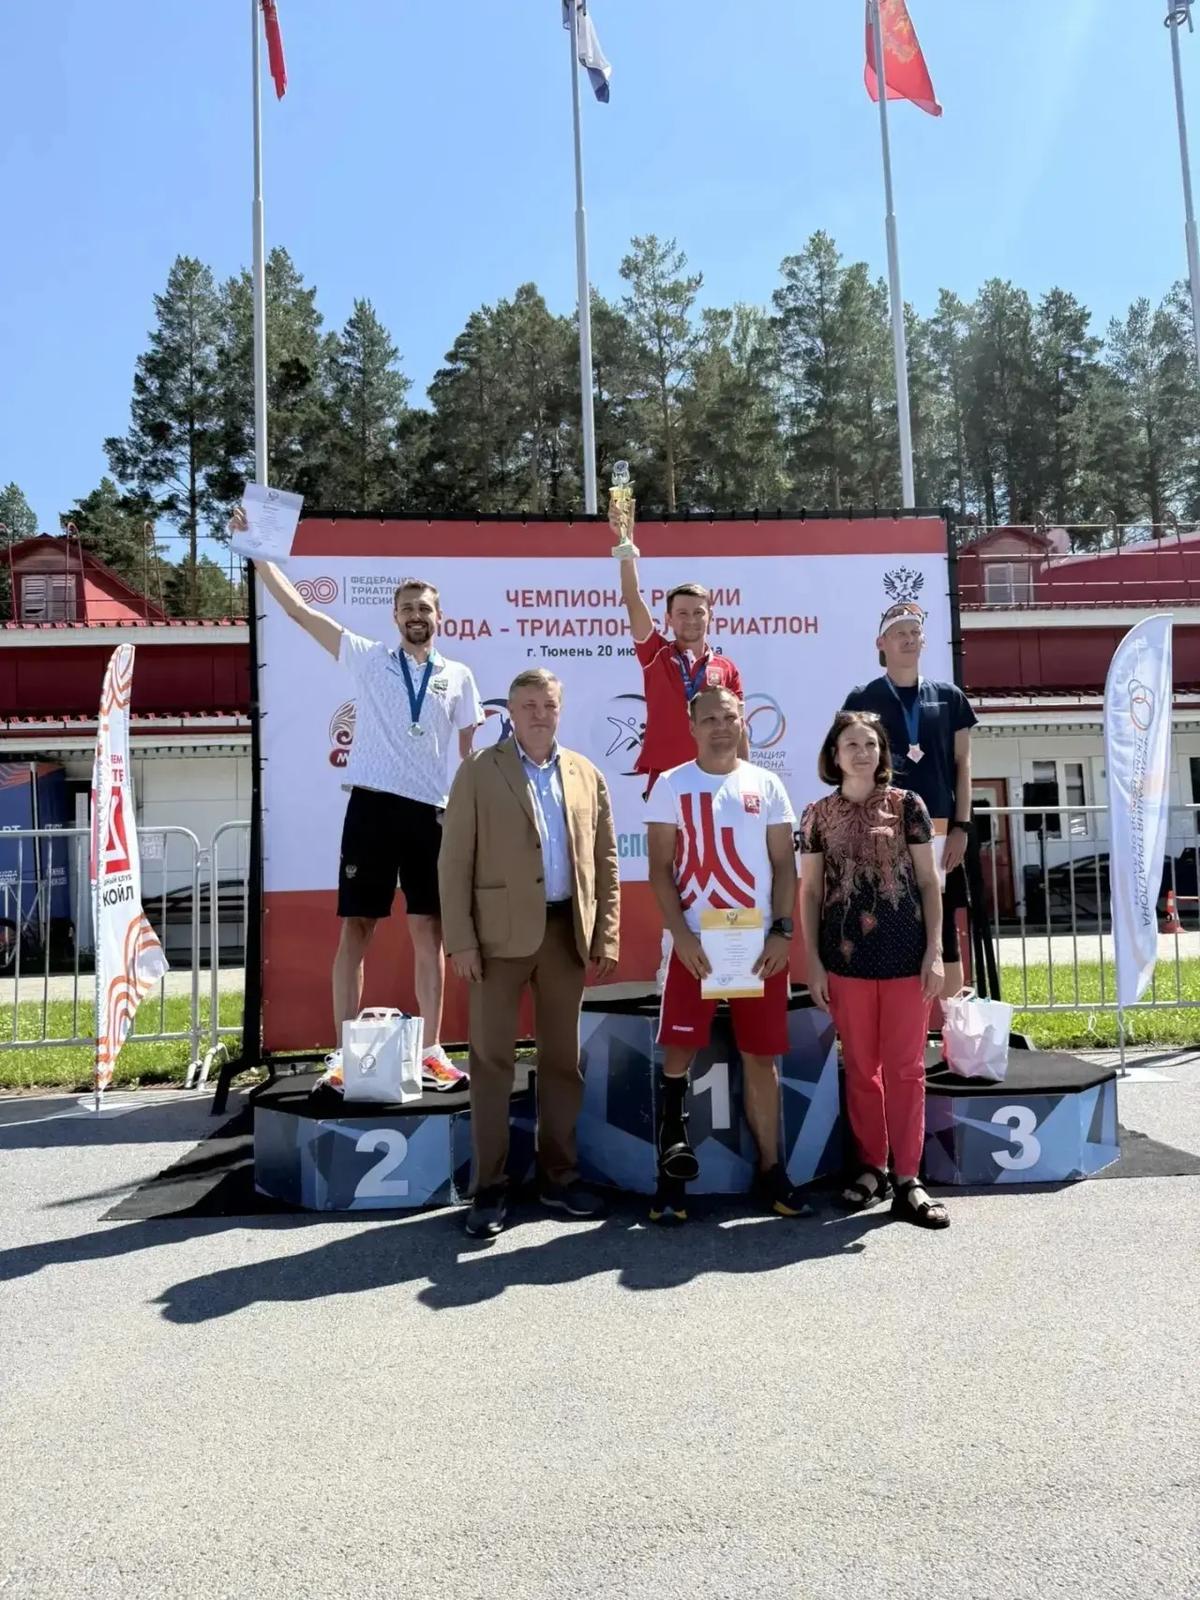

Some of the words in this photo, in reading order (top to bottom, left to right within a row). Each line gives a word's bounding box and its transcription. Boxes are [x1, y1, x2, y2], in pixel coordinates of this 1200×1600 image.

[351, 586, 396, 595] ТРИАТЛ
[351, 597, 393, 606] РОССИИ
[506, 589, 646, 607] ЧЕМПИОН
[540, 645, 593, 657] Тюмень
[597, 645, 613, 657] 20
[1138, 836, 1151, 927] ТРИАТЛОНА
[692, 1062, 732, 1130] 1
[991, 1104, 1042, 1171] 3
[354, 1128, 409, 1198] 2
